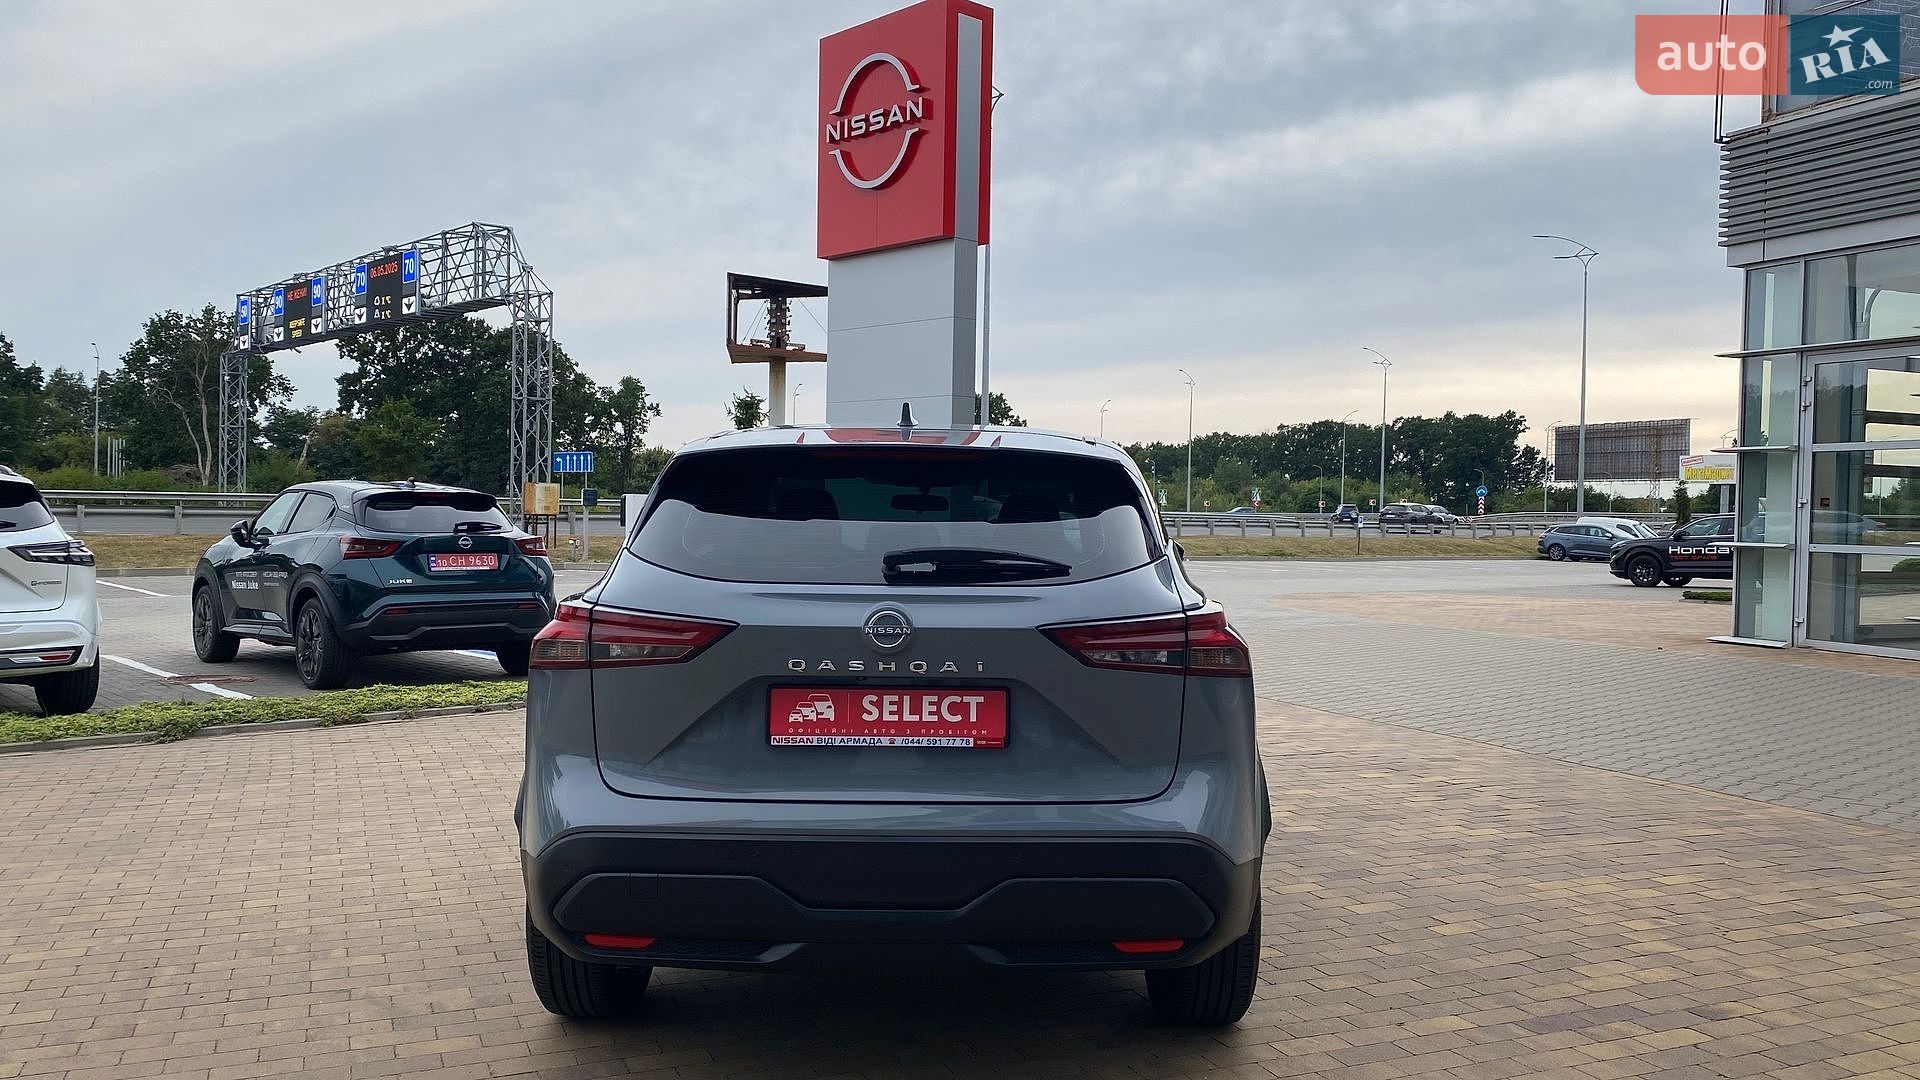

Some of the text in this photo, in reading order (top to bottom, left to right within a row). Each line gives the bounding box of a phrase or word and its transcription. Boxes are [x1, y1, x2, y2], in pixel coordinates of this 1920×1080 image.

[826, 96, 924, 144] NISSAN
[404, 257, 414, 275] 70
[357, 271, 365, 287] 70
[1668, 546, 1730, 554] Honda
[468, 555, 495, 566] 9630
[865, 627, 911, 635] NISSAN
[861, 694, 984, 722] SELECT
[816, 737, 836, 745] ВІДІ
[840, 737, 883, 745] АРМАДА
